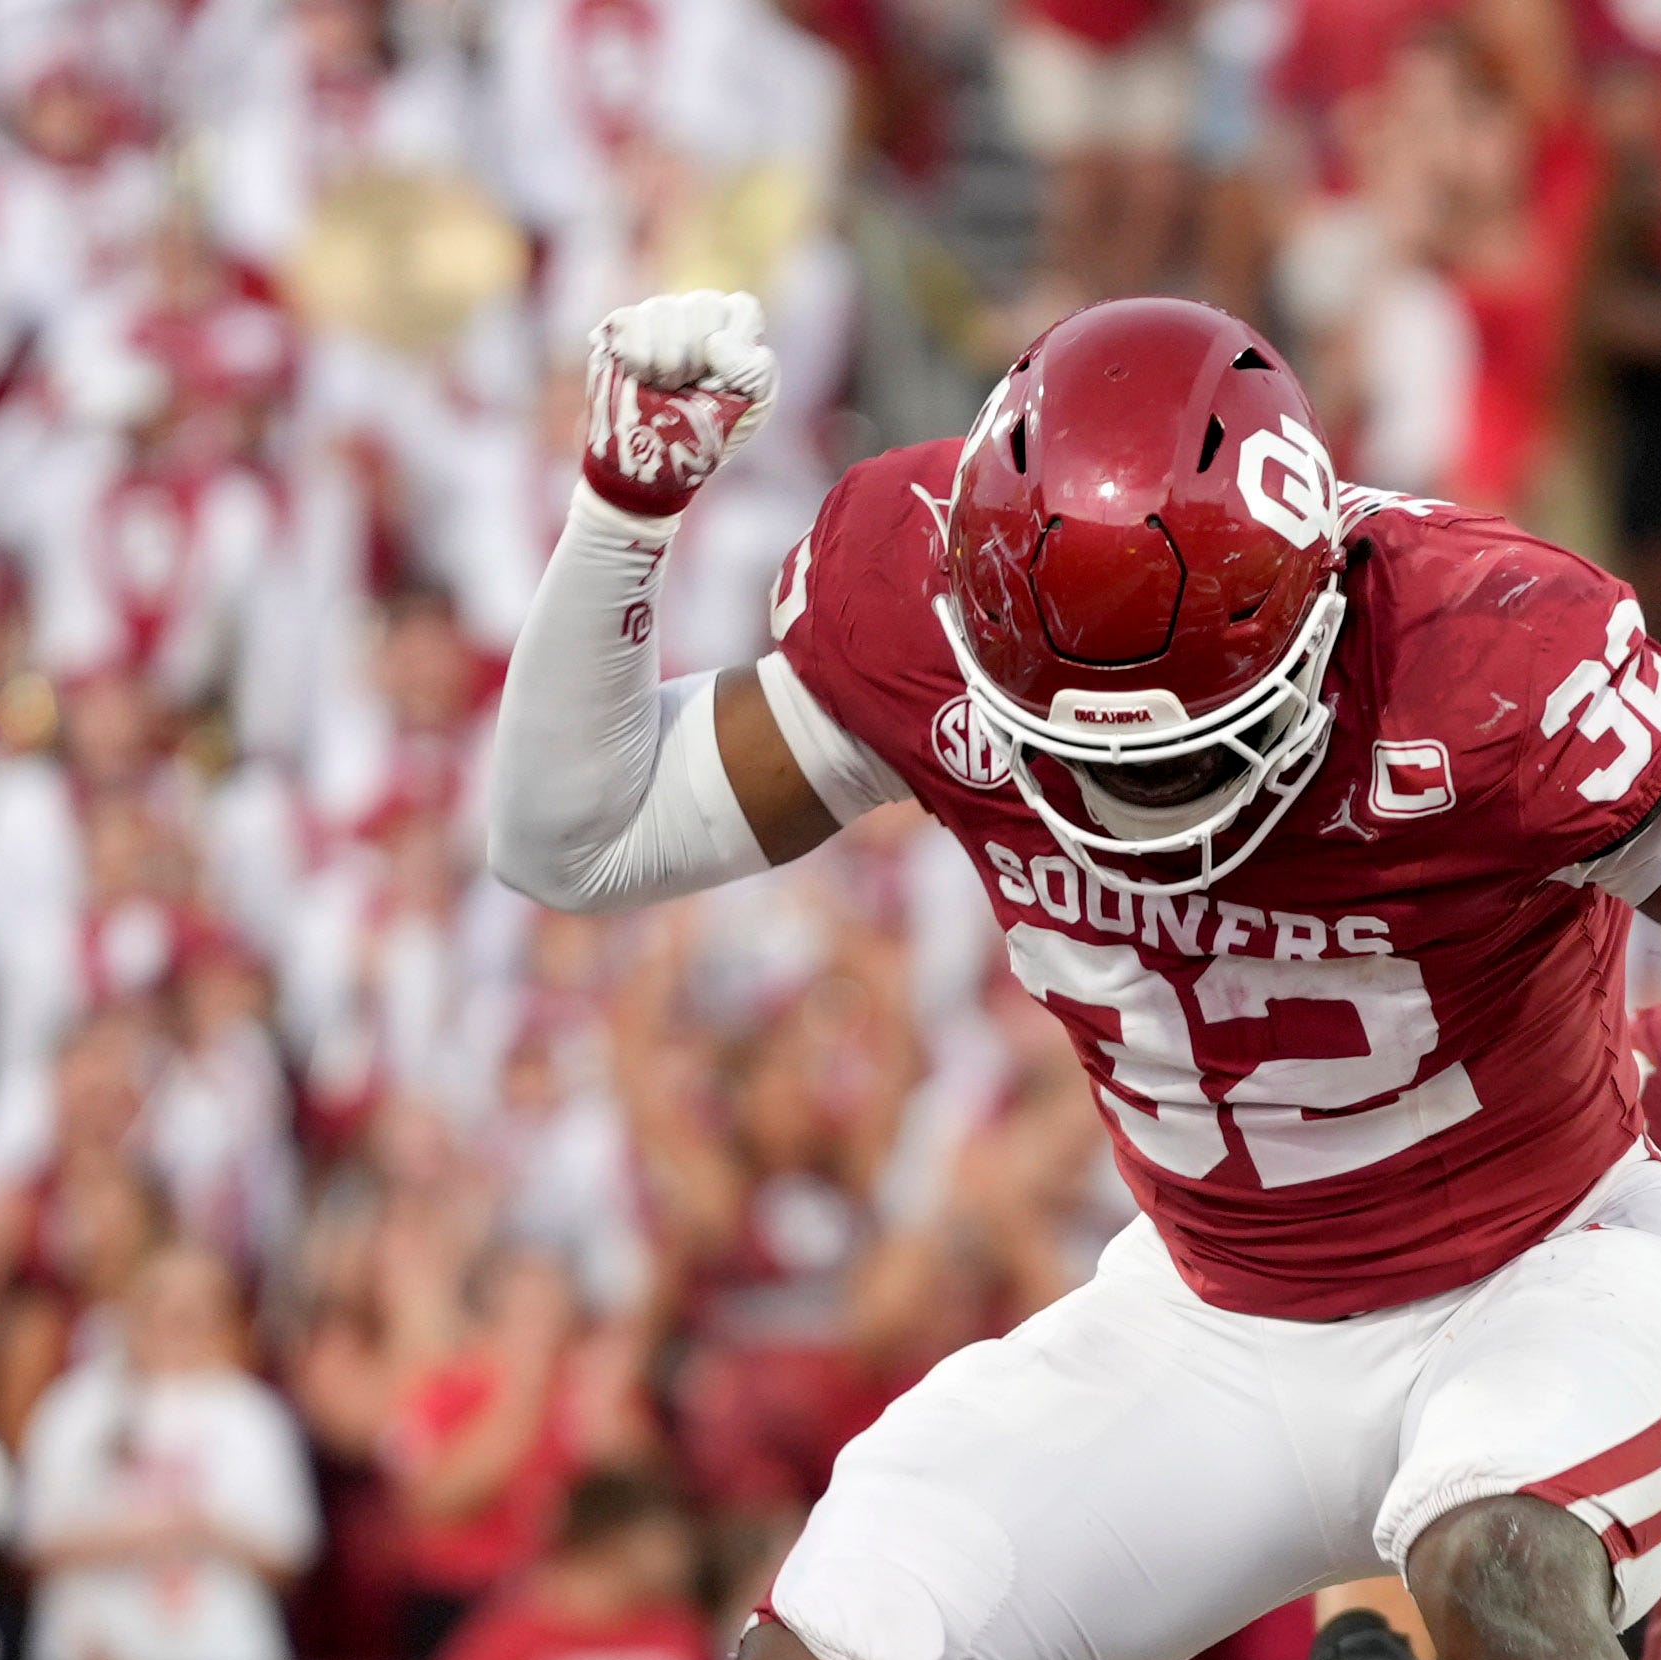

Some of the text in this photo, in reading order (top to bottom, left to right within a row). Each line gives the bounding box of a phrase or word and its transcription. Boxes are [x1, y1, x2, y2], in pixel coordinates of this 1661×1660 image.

[1236, 413, 1340, 550] OU
[1074, 708, 1153, 724] OKLAHOMA
[1375, 747, 1448, 812] C
[984, 841, 1395, 962] SOONERS
[1007, 920, 1483, 1190] 32
